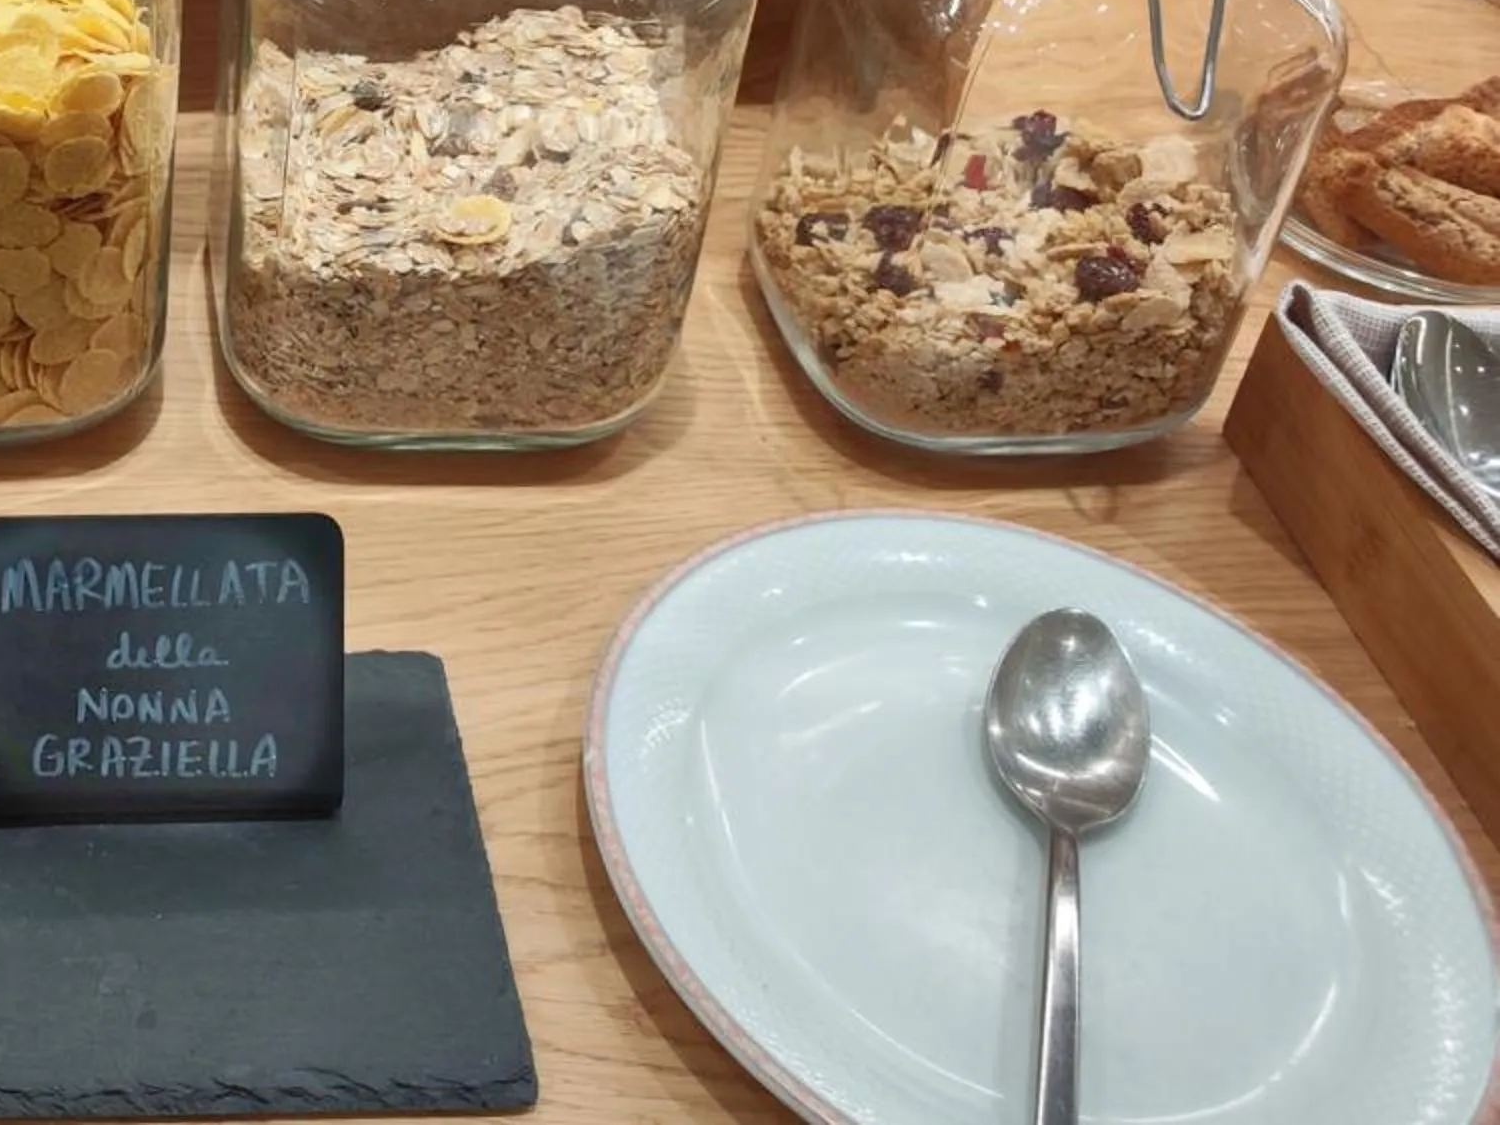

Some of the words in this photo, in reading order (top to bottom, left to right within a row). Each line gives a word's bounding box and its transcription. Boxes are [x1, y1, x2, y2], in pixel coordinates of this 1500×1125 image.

[2, 557, 310, 613] MARMELLATA
[106, 631, 230, 669] della
[76, 686, 231, 724] NONNA
[33, 732, 278, 778] GRAZIELLA
